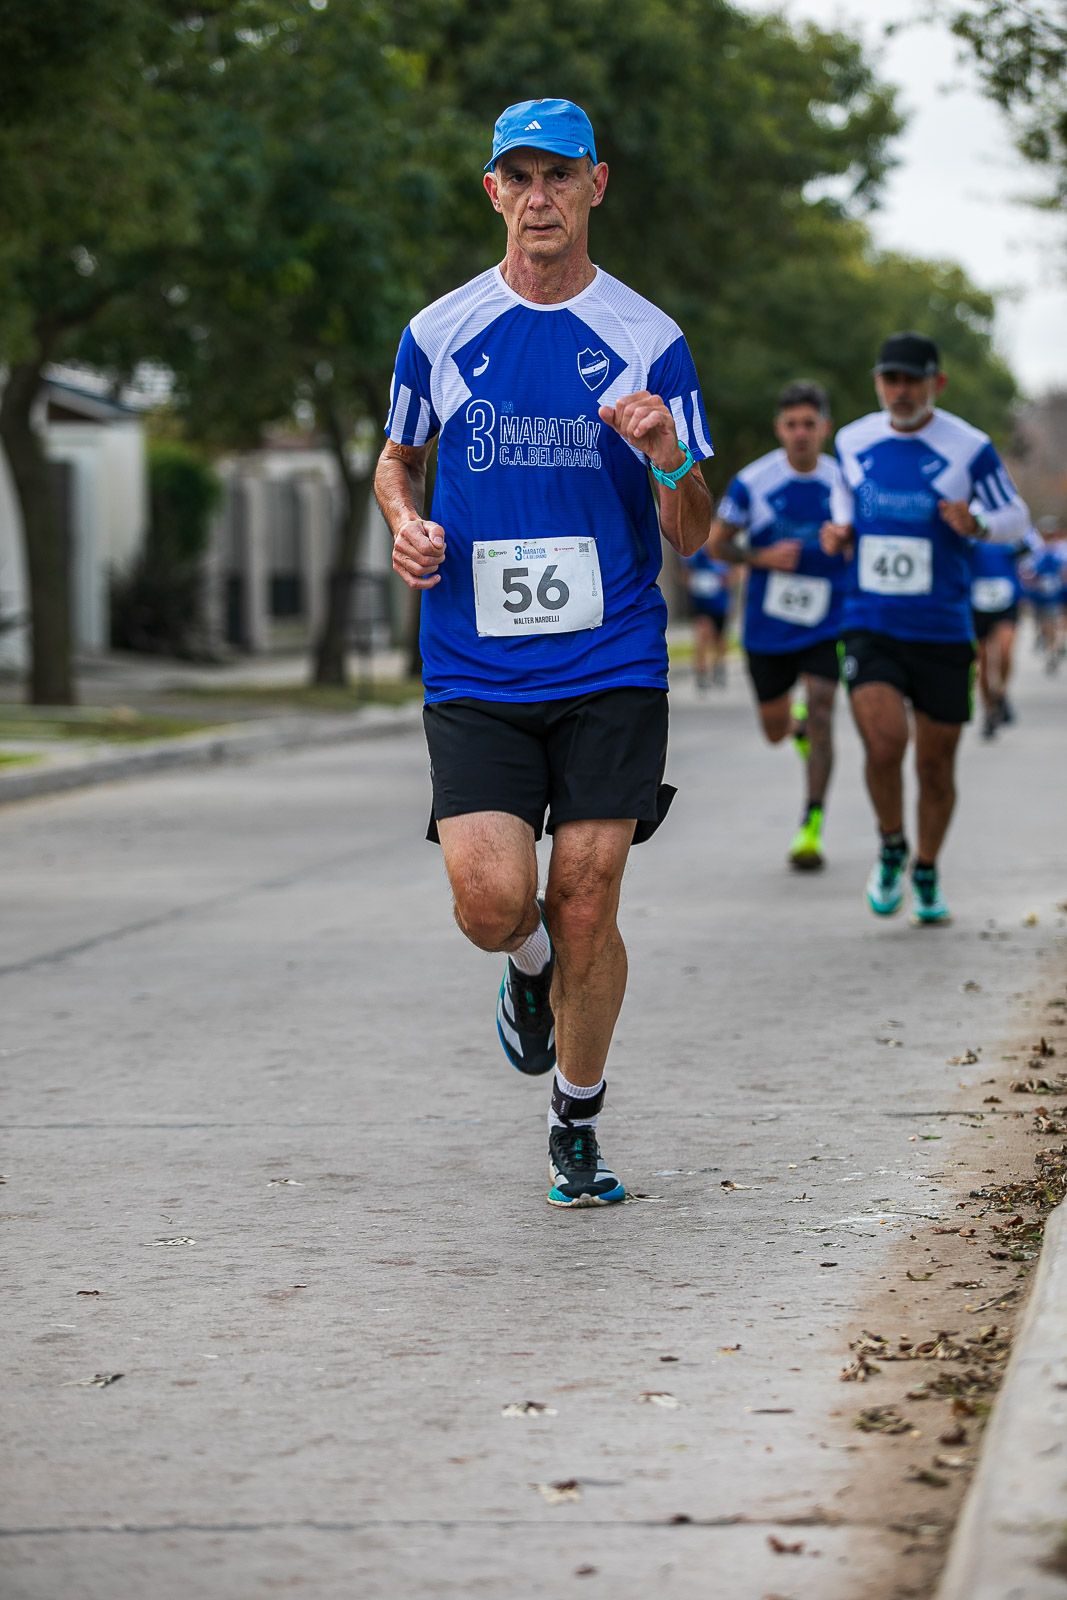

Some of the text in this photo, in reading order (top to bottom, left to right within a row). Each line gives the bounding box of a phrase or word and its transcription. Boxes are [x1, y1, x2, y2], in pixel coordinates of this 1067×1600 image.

[466, 399, 495, 471] 3
[500, 415, 600, 449] MARATÓN
[514, 545, 523, 561] 3
[873, 553, 914, 580] 40
[502, 565, 570, 613] 56
[513, 615, 560, 625] WALTER NARDELLI
